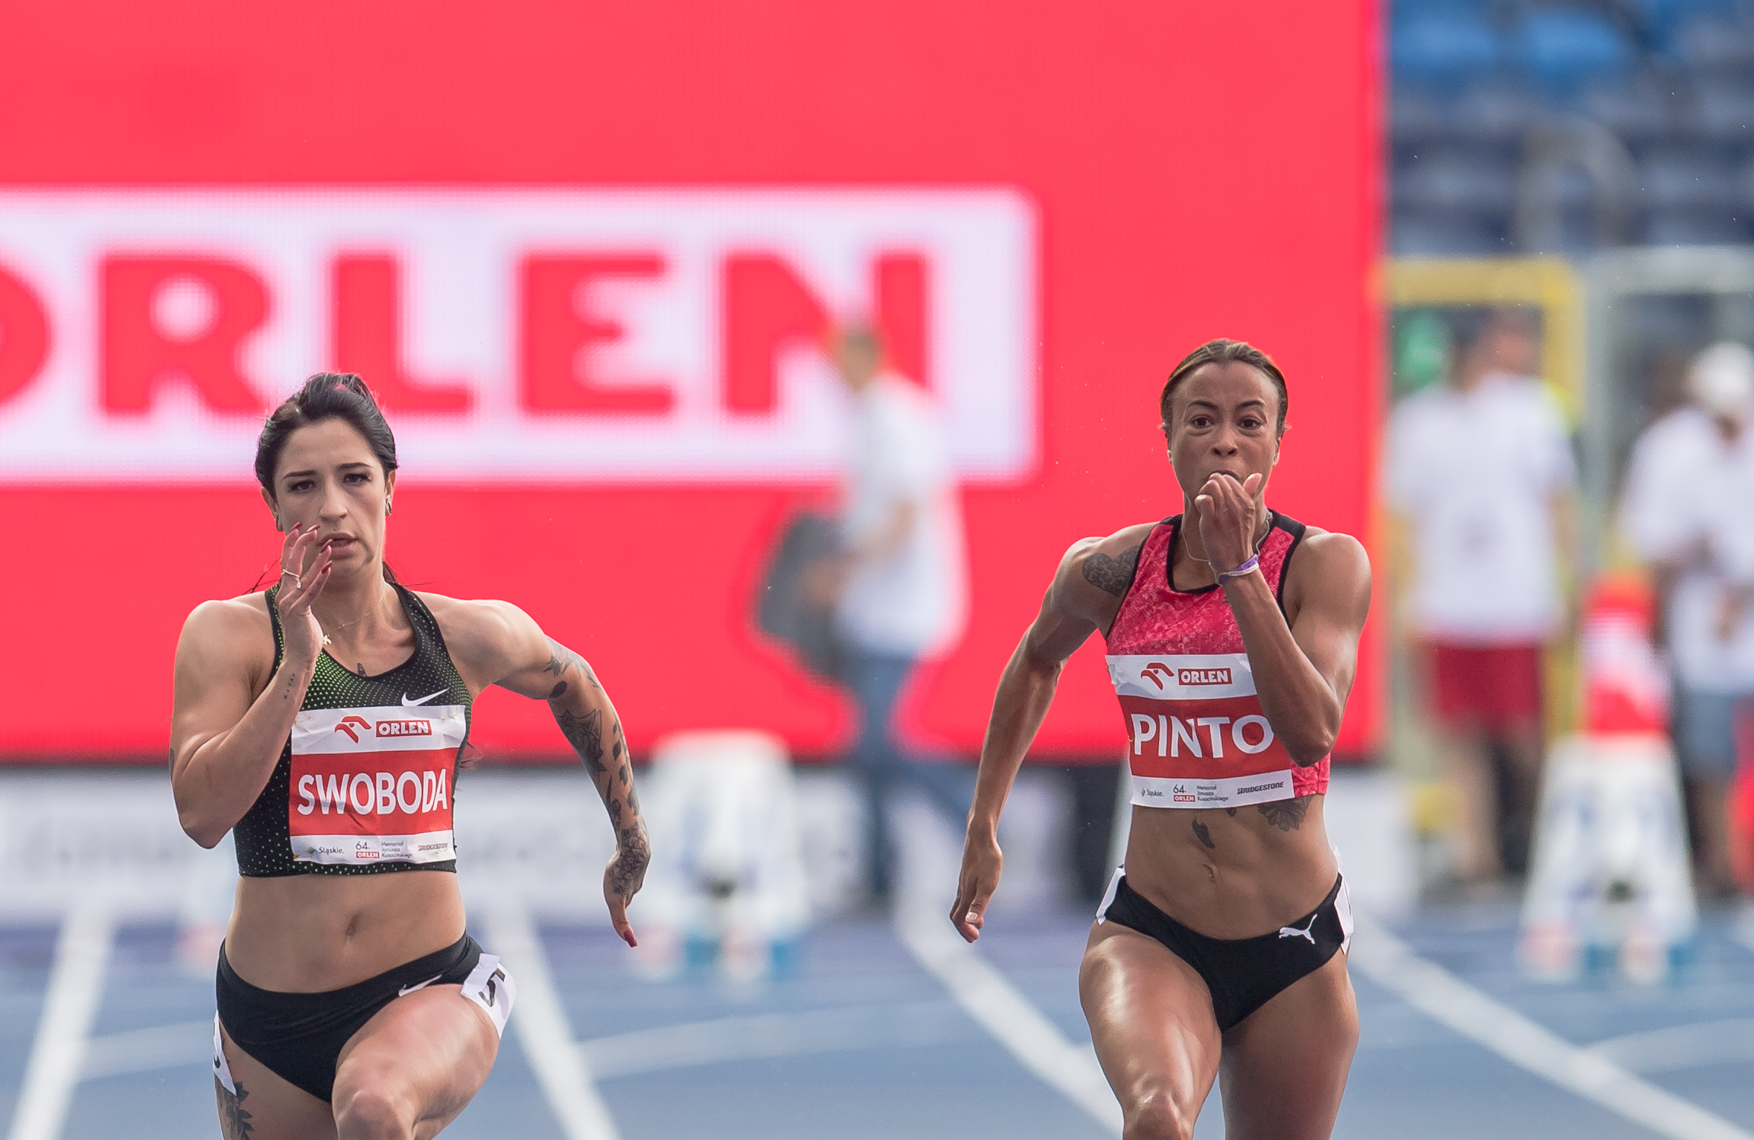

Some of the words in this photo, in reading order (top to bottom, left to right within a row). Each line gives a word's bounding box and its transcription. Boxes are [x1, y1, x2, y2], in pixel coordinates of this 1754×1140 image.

[1181, 670, 1229, 683] ORLEN
[378, 721, 429, 735] ORLEN
[1130, 713, 1274, 758] PINTO
[297, 768, 448, 816] SWOBODA
[1236, 781, 1284, 795] BRIDGESTONE
